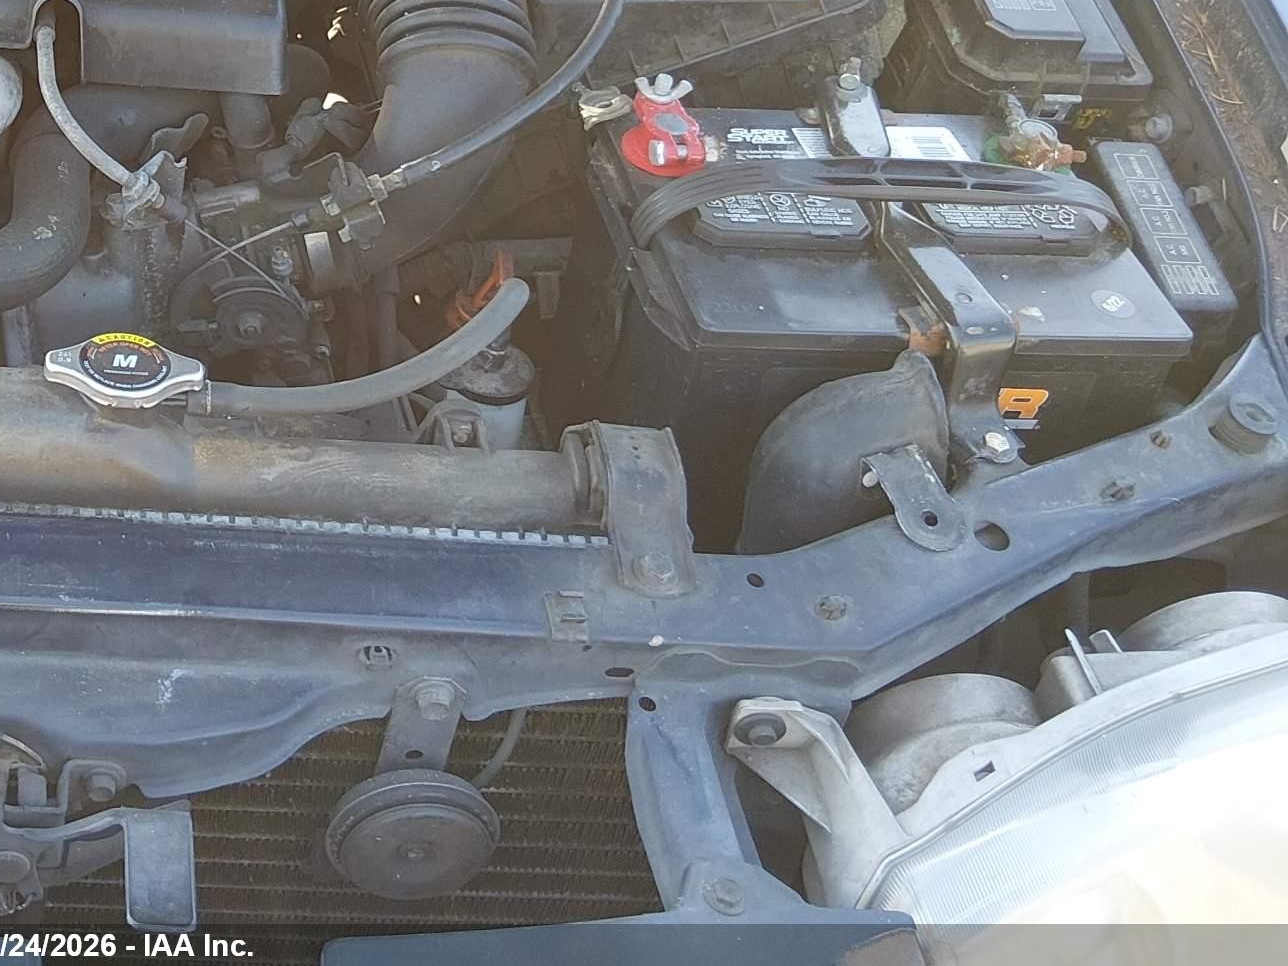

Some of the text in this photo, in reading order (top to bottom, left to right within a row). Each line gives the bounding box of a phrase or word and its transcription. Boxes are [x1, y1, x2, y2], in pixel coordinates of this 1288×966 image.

[730, 127, 787, 135] SUPER
[727, 133, 790, 143] START
[106, 334, 151, 346] CAUTION
[112, 353, 138, 369] M
